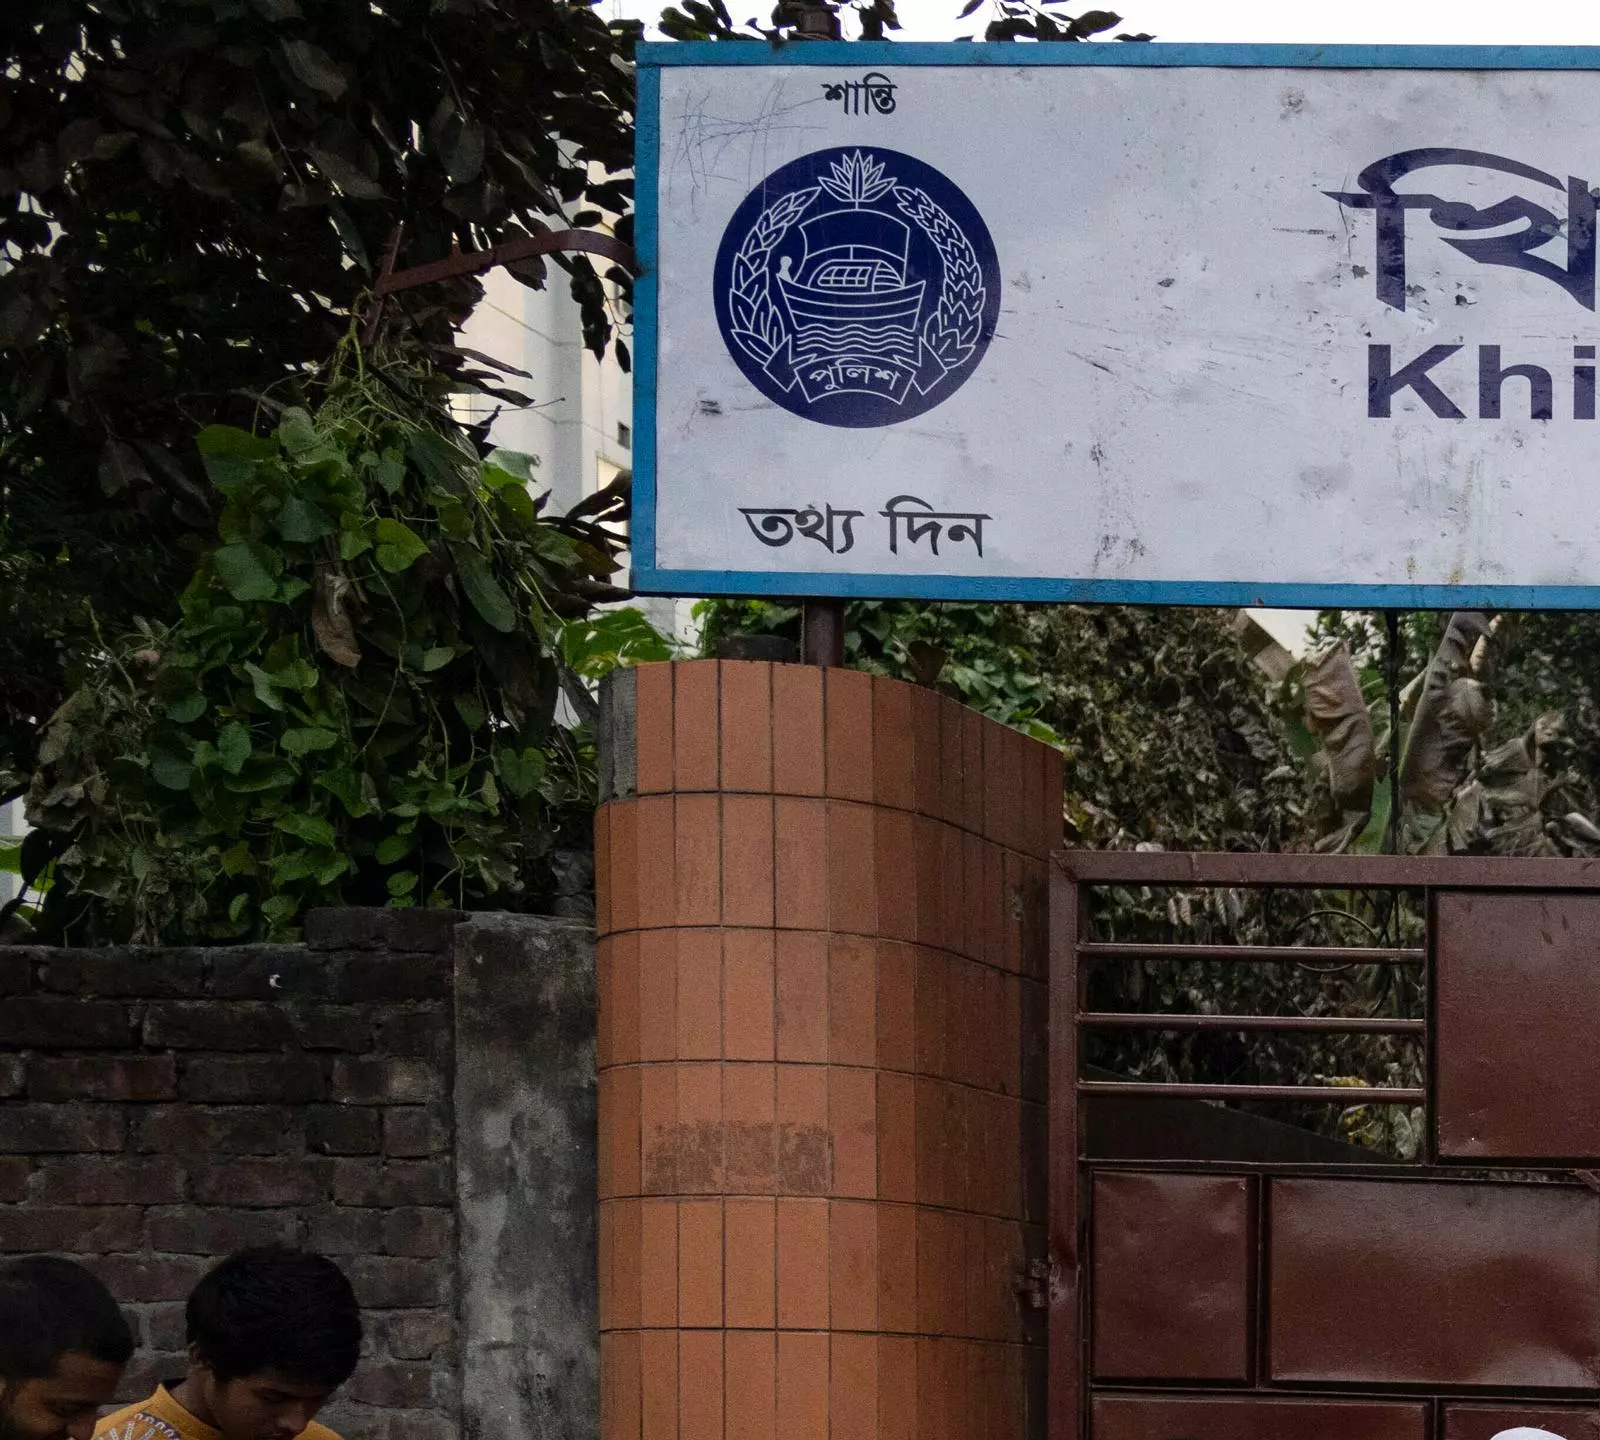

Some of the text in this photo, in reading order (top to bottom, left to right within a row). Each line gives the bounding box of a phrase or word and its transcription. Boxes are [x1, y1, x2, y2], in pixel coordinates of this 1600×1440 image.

[821, 72, 897, 115] শান্তি
[808, 357, 902, 391] পুলিশ
[738, 495, 993, 559] তথ্য দিন
